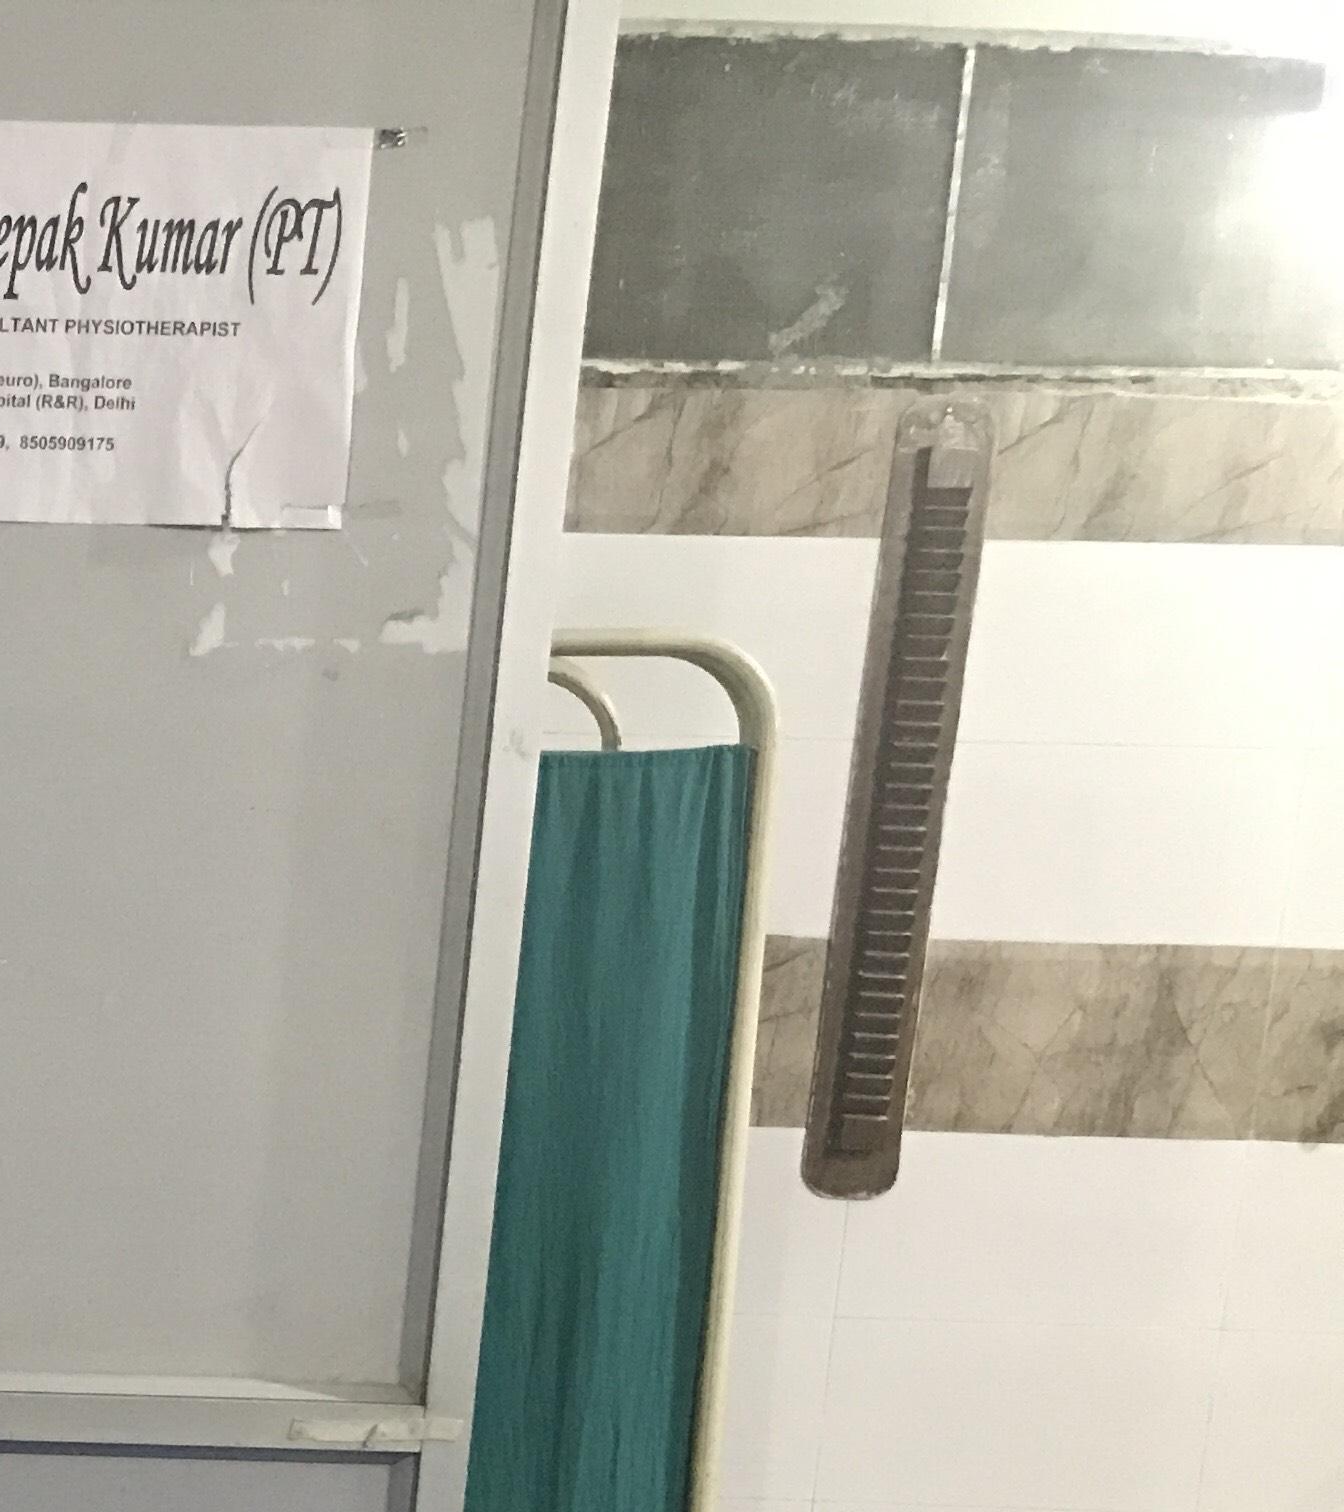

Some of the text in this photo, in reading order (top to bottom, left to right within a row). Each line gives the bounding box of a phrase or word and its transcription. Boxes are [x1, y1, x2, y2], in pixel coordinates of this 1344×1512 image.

[97, 195, 243, 290] Kumar
[247, 185, 343, 306] (PT)
[64, 319, 241, 338] PHYSIOTHERAPIST
[48, 374, 132, 391] Bangalore
[35, 394, 89, 412] (R&R),
[94, 396, 136, 411] Delhi
[19, 435, 115, 452] 8505909175
